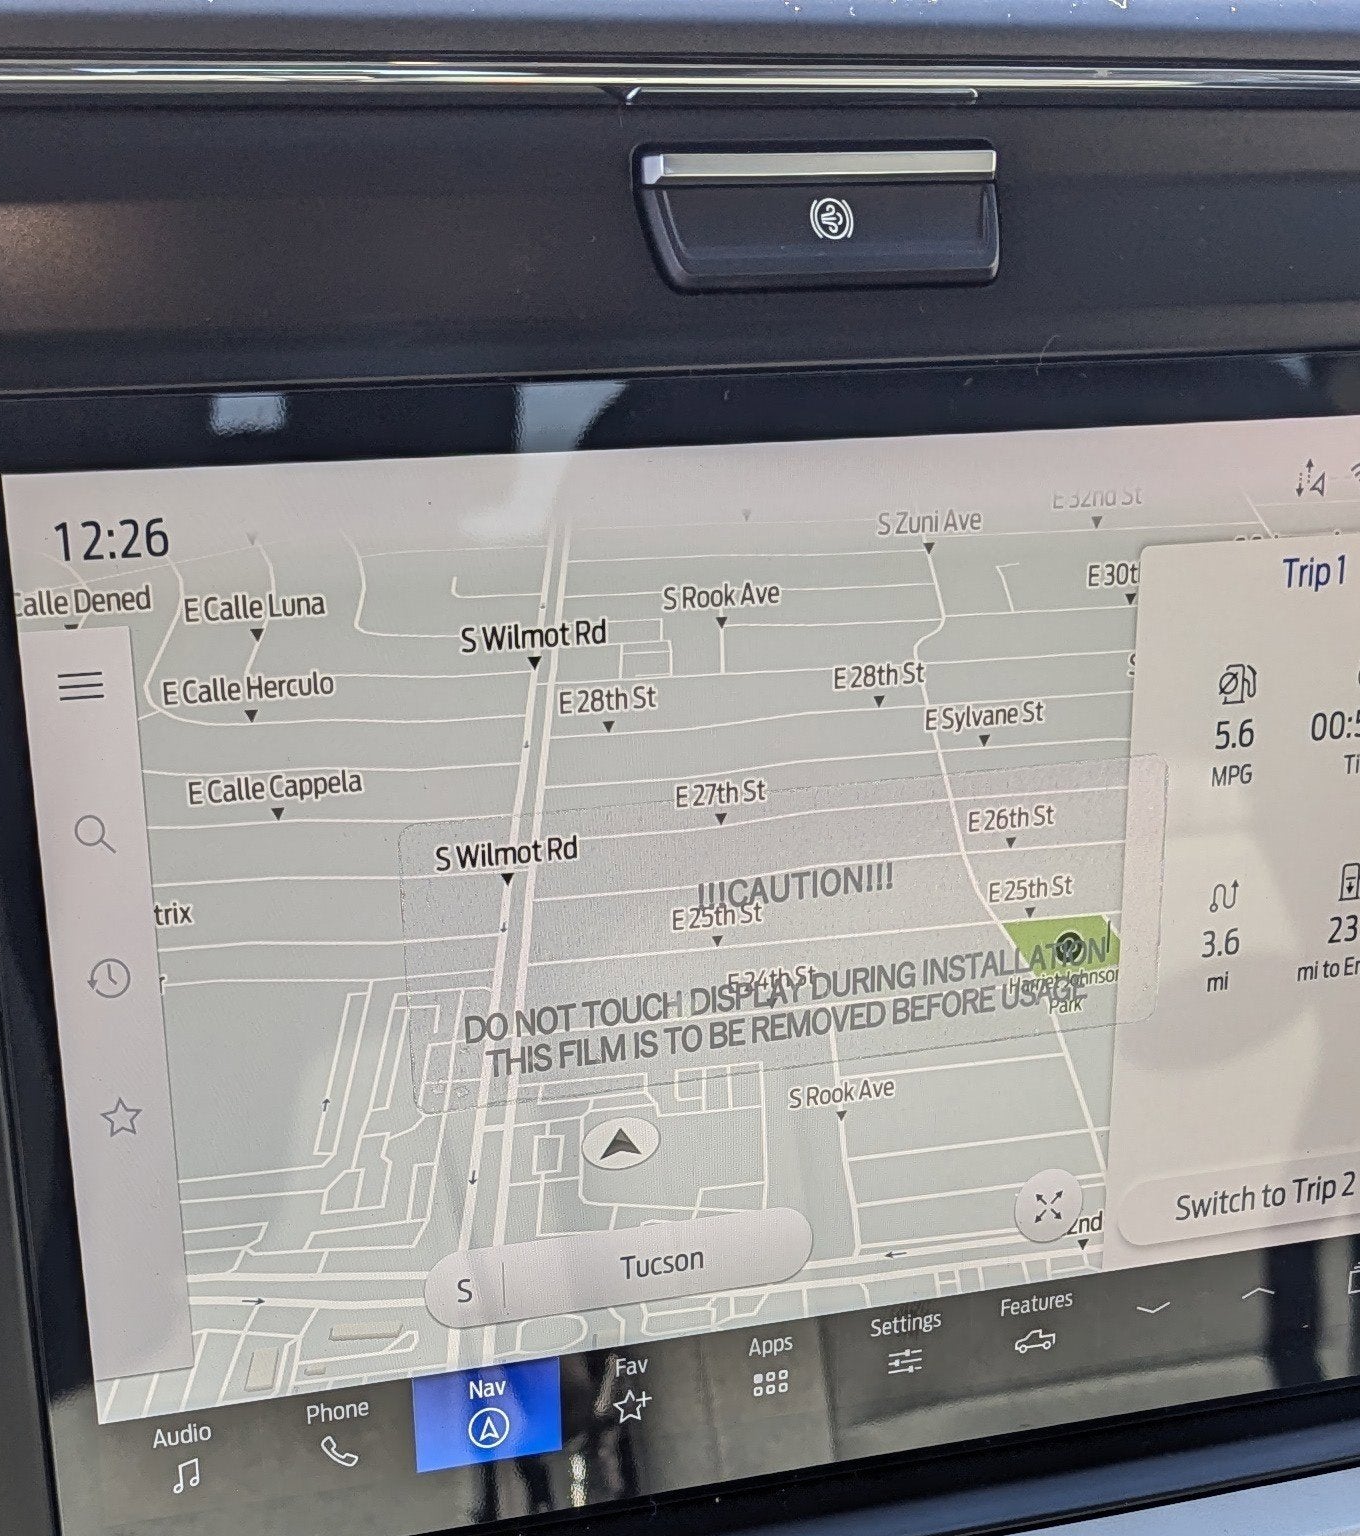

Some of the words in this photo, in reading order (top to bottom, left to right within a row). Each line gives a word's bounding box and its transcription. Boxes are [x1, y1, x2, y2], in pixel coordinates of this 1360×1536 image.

[877, 512, 891, 534] S
[895, 509, 940, 534] Zuni
[943, 510, 983, 532] Ave
[53, 517, 170, 562] 12:26
[1088, 564, 1100, 587] E
[1104, 562, 1140, 586] 30t
[1282, 558, 1331, 592] Trip
[1336, 555, 1347, 583] 1
[73, 584, 152, 614] Dened
[184, 599, 196, 622] E
[198, 595, 264, 621] Calle
[268, 592, 326, 618] Luna
[662, 587, 677, 610] S
[681, 583, 736, 609] Rook
[740, 584, 781, 606] Ave
[460, 626, 477, 653] S
[481, 619, 571, 651] Wilmot
[575, 618, 608, 647] Rd
[162, 680, 175, 706] E
[177, 678, 242, 703] Calle
[246, 671, 335, 700] Herculo
[833, 667, 847, 690] E
[851, 663, 900, 688] 28th
[903, 661, 926, 684] St
[558, 692, 572, 715] E
[575, 688, 629, 713] 28th
[633, 687, 657, 710] St
[925, 708, 939, 731] E
[942, 702, 1019, 732] Sylvane
[1022, 700, 1045, 724] St
[1214, 719, 1255, 750] 5.6
[188, 780, 203, 804] E
[206, 777, 265, 802] Calle
[268, 771, 364, 806] Cappela
[1211, 764, 1253, 787] MPG
[676, 785, 688, 808] E
[691, 782, 740, 806] 27th
[743, 780, 767, 803] St
[968, 810, 982, 832] E
[984, 806, 1032, 831] 26th
[1036, 804, 1056, 828] St
[435, 846, 451, 871] S
[453, 840, 542, 869] Wilmot
[547, 835, 579, 863] Rd
[990, 882, 1001, 903] E
[1003, 879, 1048, 902] 25th
[1052, 875, 1074, 896] St
[672, 909, 684, 930] E
[689, 902, 736, 929] 25th
[740, 901, 763, 924] St
[1201, 928, 1240, 959] 3.6
[1206, 971, 1229, 992] mi
[1296, 961, 1319, 982] mi
[1322, 958, 1340, 979] to
[464, 1011, 508, 1044] DO
[515, 1003, 577, 1037] NOT
[582, 990, 683, 1028] TOUCH
[690, 976, 803, 1016] DISPLAY
[811, 960, 916, 1001] DURING
[922, 936, 1108, 986] INSTALLATION
[486, 1043, 553, 1078] THIS
[559, 1033, 626, 1069] FILM
[634, 1030, 659, 1060] IS
[664, 1023, 703, 1055] TO
[709, 1018, 746, 1049] BE
[751, 1001, 887, 1044] REMOVED
[892, 986, 995, 1026] BEFORE
[1001, 977, 1088, 1010] USAGE
[789, 1087, 802, 1109] S
[806, 1082, 854, 1105] Rook
[858, 1079, 895, 1100] Ave
[1174, 1185, 1256, 1221] Switch
[1261, 1180, 1286, 1208] to
[1291, 1176, 1338, 1204] Trip
[1342, 1171, 1357, 1197] 2
[620, 1250, 704, 1280] Tucson
[456, 1279, 472, 1303] S
[1000, 1290, 1074, 1318] Features
[870, 1311, 942, 1340] Settings
[749, 1333, 793, 1358] Apps
[614, 1356, 649, 1379] Fav
[468, 1379, 507, 1401] Nav
[306, 1400, 370, 1425] Phone
[152, 1424, 213, 1450] Audio
